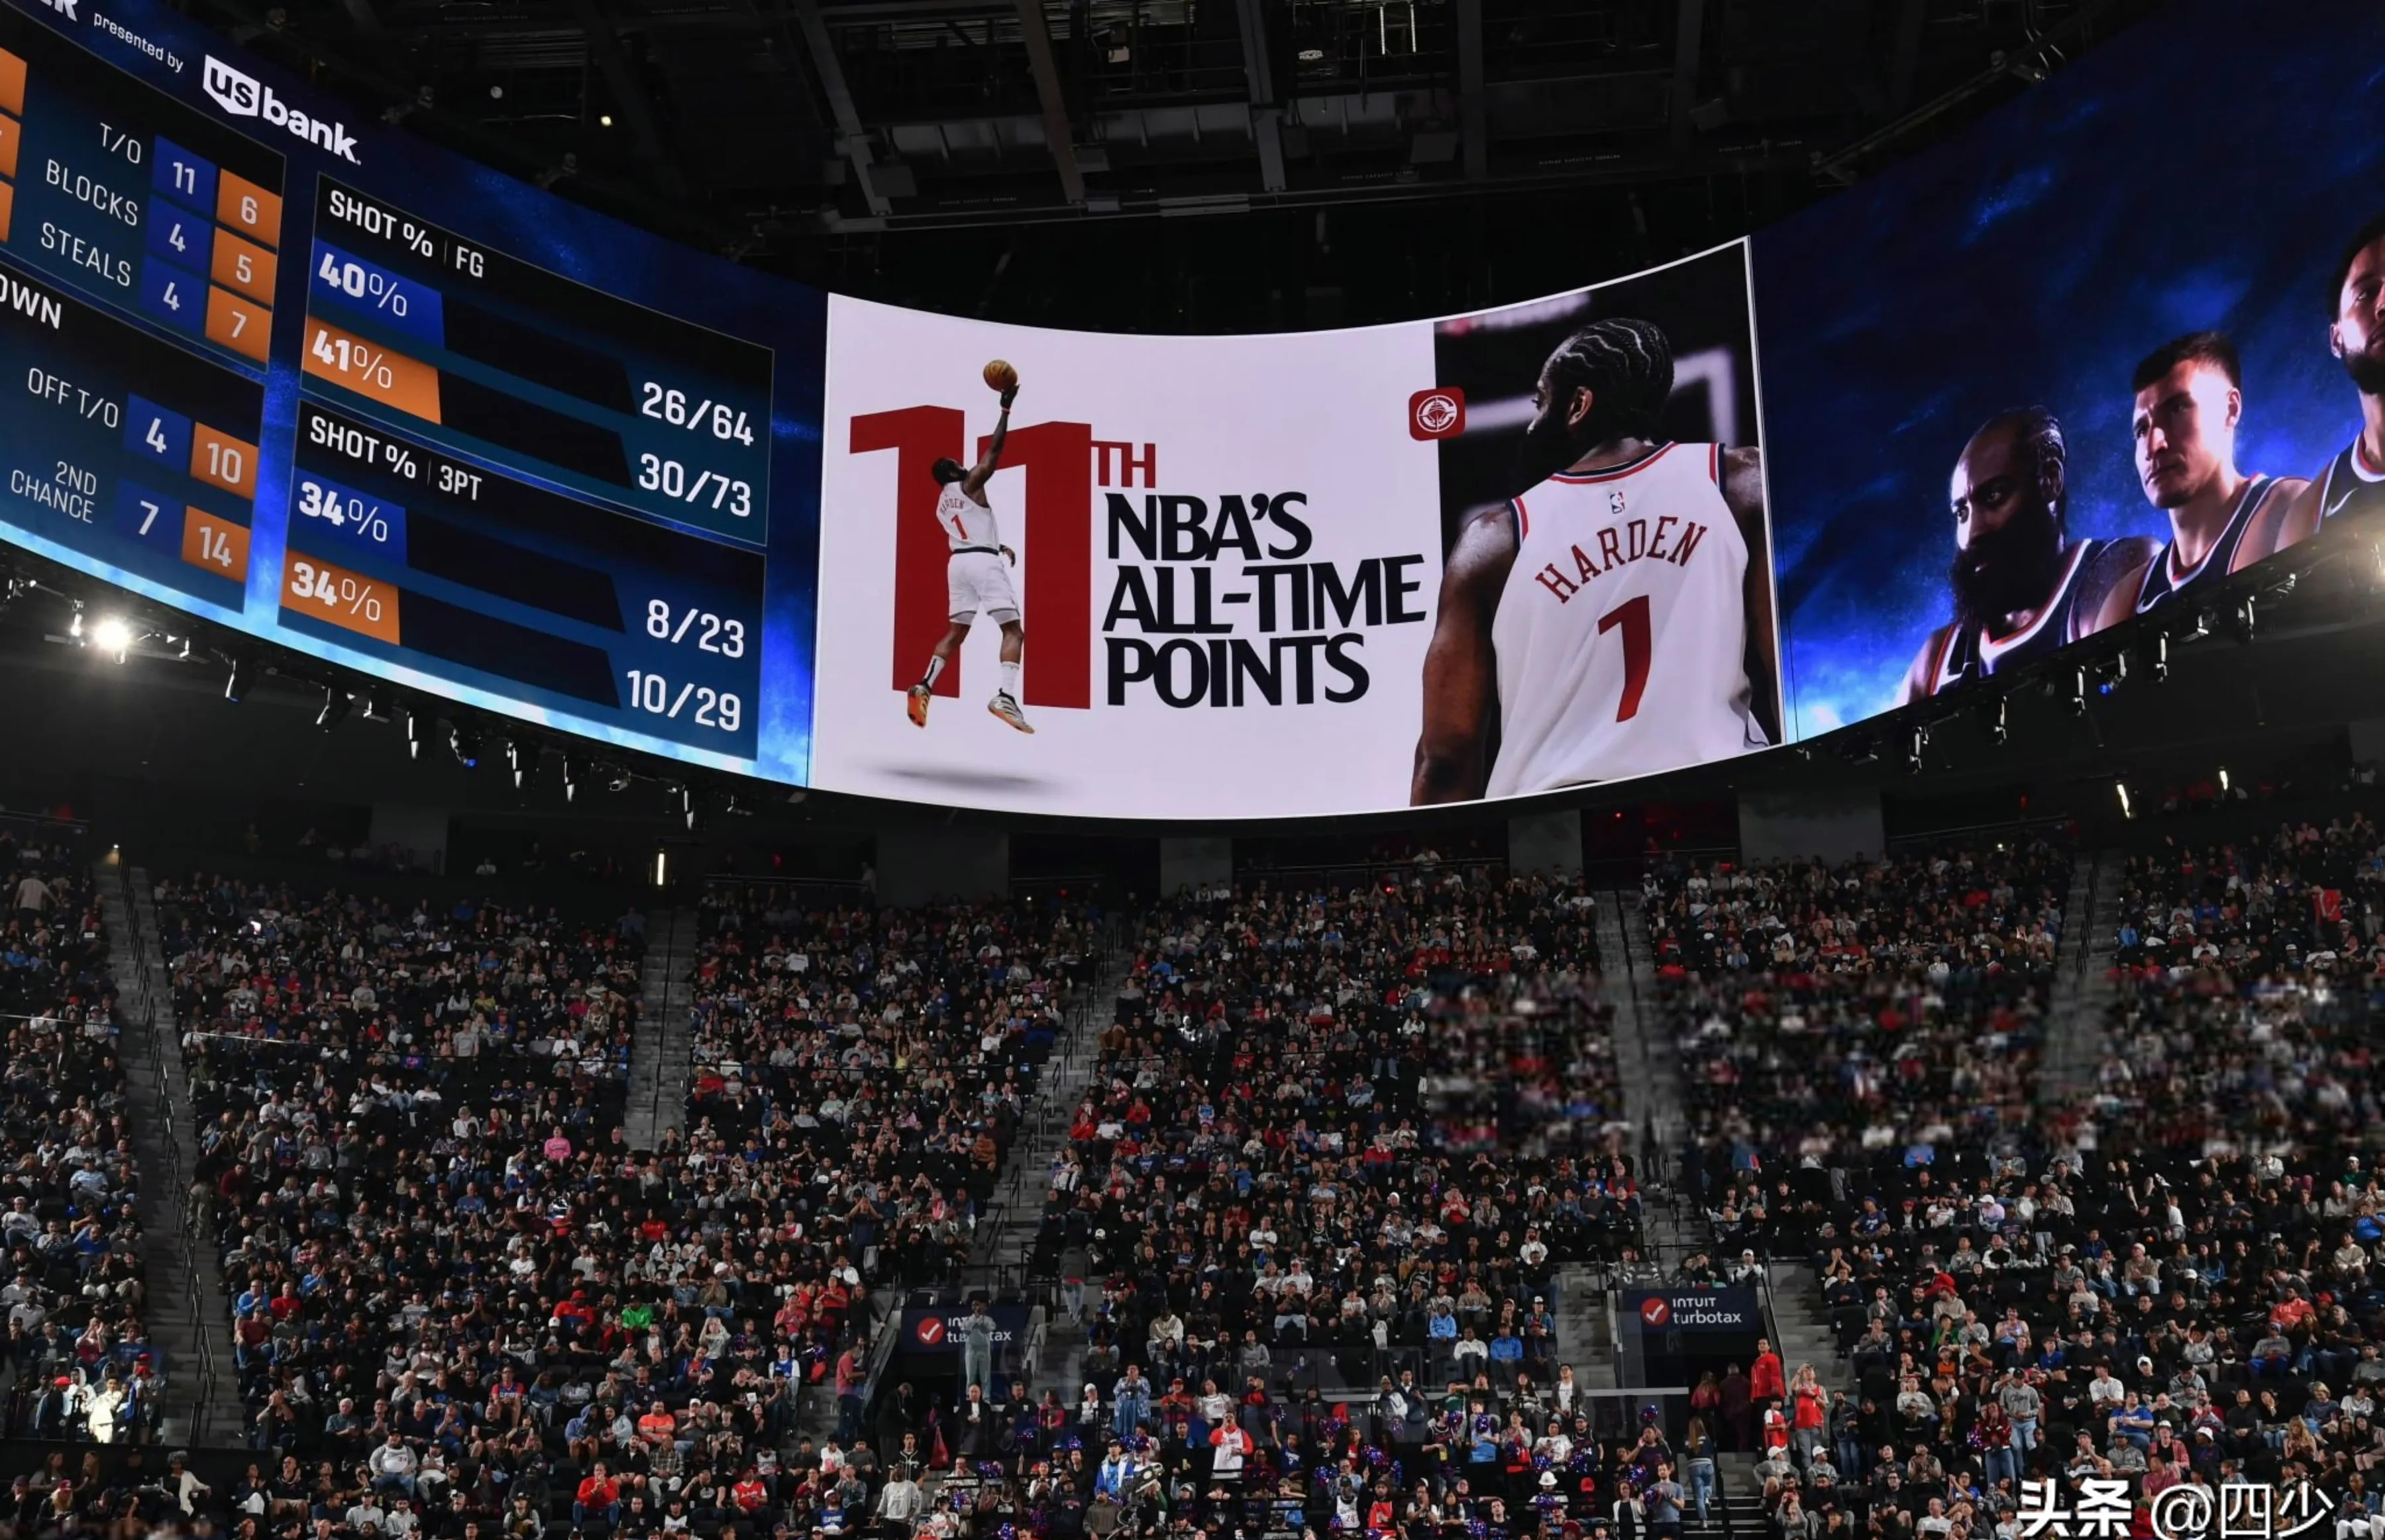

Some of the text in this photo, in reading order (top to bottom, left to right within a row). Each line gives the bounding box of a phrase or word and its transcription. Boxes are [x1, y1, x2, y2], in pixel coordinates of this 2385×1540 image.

[93, 12, 184, 73] presented by
[209, 67, 254, 109] us
[100, 123, 258, 225] T/O 11 6
[46, 159, 252, 284] BLOCKS 4 5
[329, 189, 484, 279] SHOT % FG
[41, 222, 247, 338] STEALS 4 7
[319, 252, 408, 318] 40%
[312, 329, 392, 389] 41%
[28, 368, 242, 484] OFF T/O 4 10
[641, 382, 754, 446] 26/64
[55, 461, 97, 496] 2ND
[309, 415, 483, 501] SHOT % 3PT
[639, 453, 751, 518] 30/73
[11, 469, 95, 523] CHANCE
[298, 482, 388, 543] 34%
[951, 514, 968, 540] 1
[1105, 491, 1313, 561] NBA'S
[139, 500, 233, 567] 7 14
[1535, 515, 1707, 605] HARDEN
[290, 562, 381, 622] 34%
[1102, 554, 1428, 634] ALL-TIME
[646, 599, 745, 659] 8/23
[626, 670, 741, 732] 10/29
[1106, 633, 1371, 709] POINTS
[1672, 1297, 1717, 1308] INTUIT
[1672, 1309, 1742, 1324] turbotax
